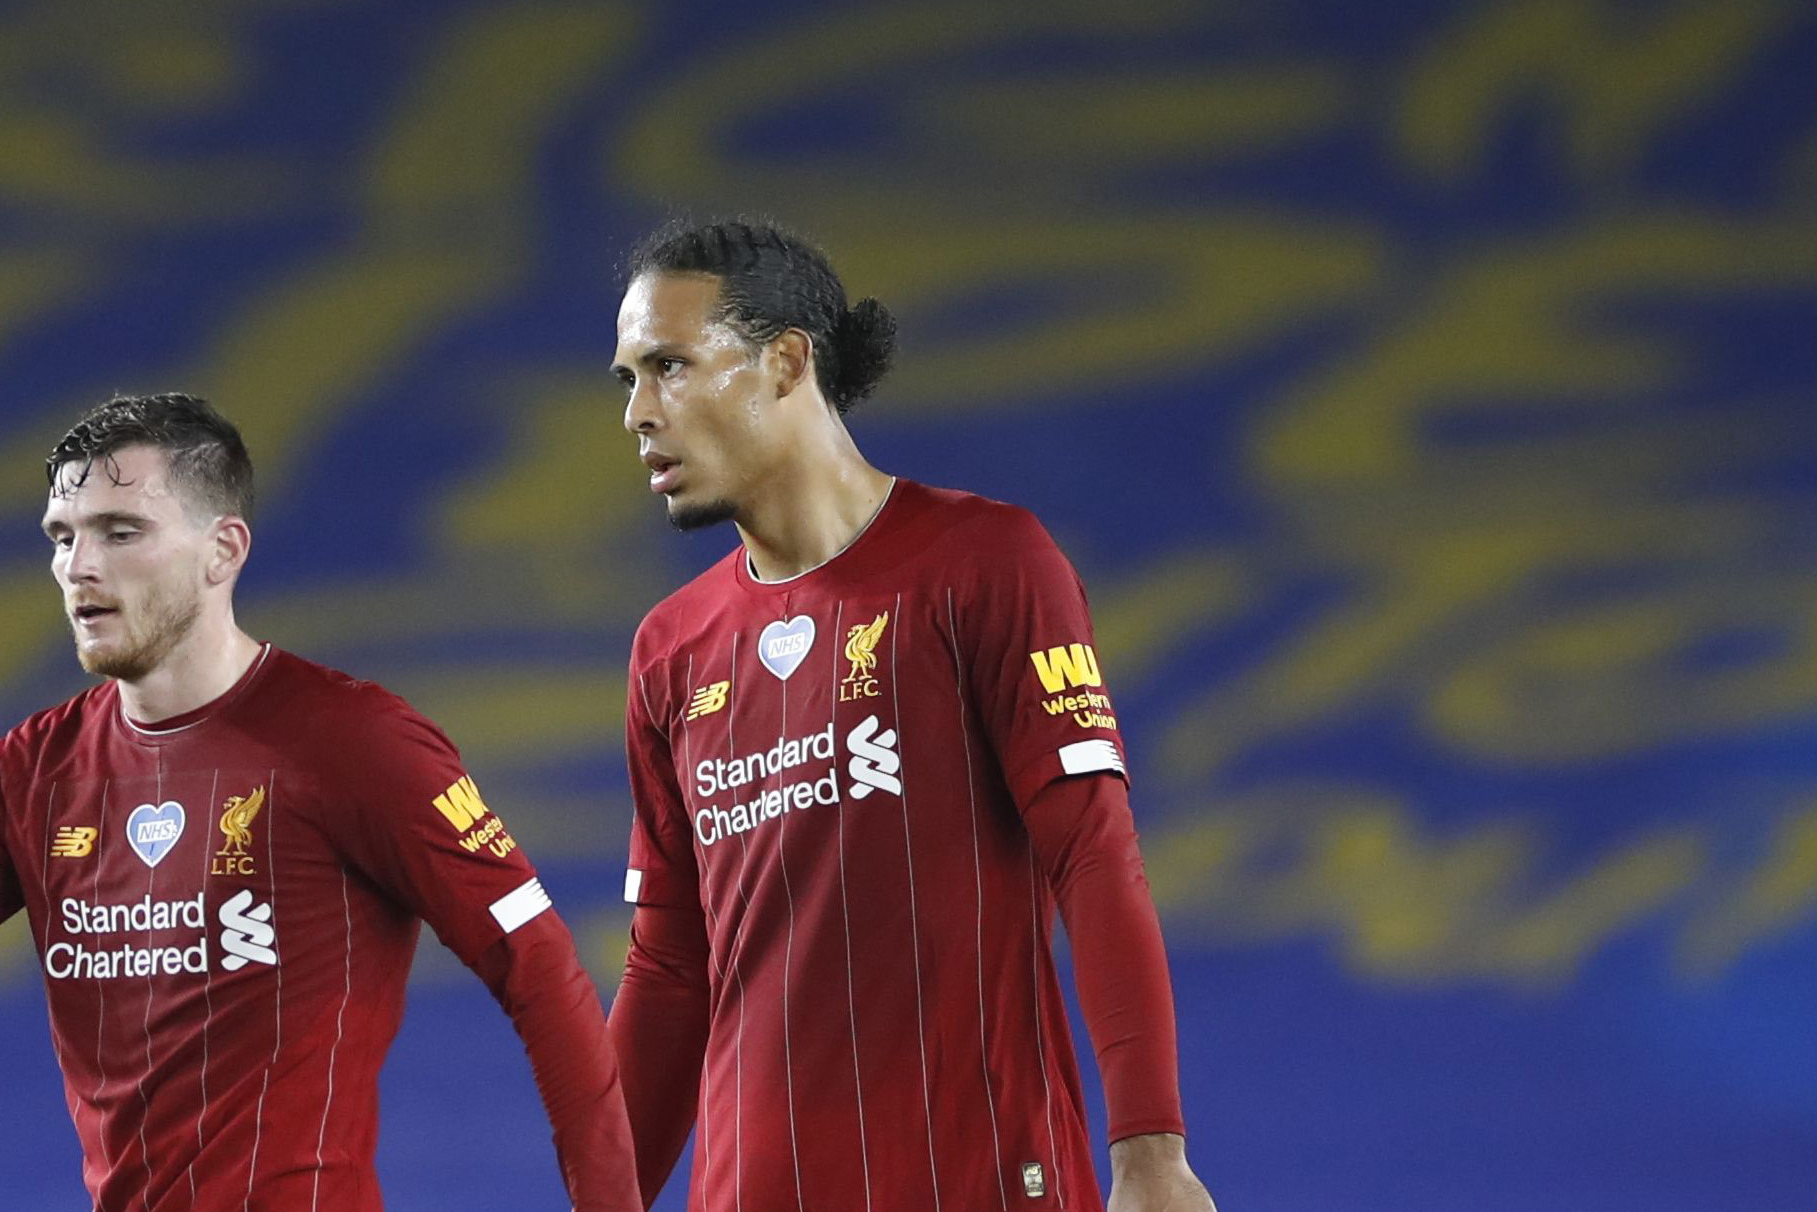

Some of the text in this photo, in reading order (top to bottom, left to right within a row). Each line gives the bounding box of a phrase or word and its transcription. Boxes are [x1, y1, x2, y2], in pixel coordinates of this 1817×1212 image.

[770, 635, 803, 656] NHS
[1073, 709, 1117, 730] Union
[696, 722, 836, 798] Standard
[695, 767, 841, 846] Chartered
[139, 822, 173, 841] NHS
[61, 891, 206, 935] Standard
[46, 936, 209, 980] Chartered
